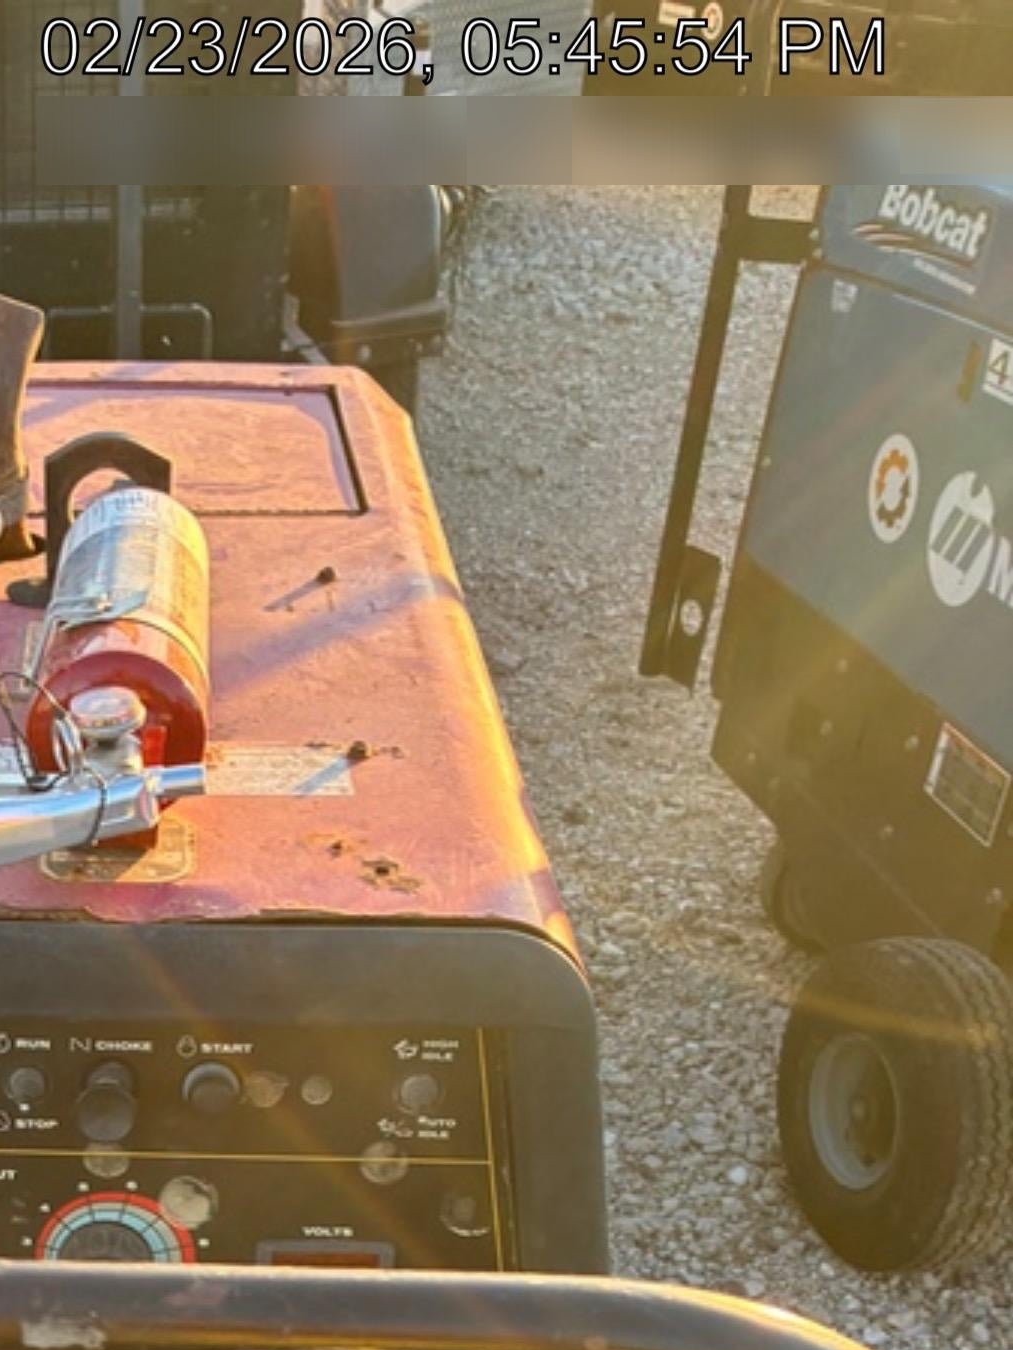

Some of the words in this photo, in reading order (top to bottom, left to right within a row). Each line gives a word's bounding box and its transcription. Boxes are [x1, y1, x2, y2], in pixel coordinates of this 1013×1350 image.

[879, 184, 988, 258] Bobcat
[15, 1038, 51, 1049] RUN
[95, 1039, 153, 1051] CHOKE
[200, 1042, 253, 1054] START
[301, 1226, 354, 1238] VOLTS
